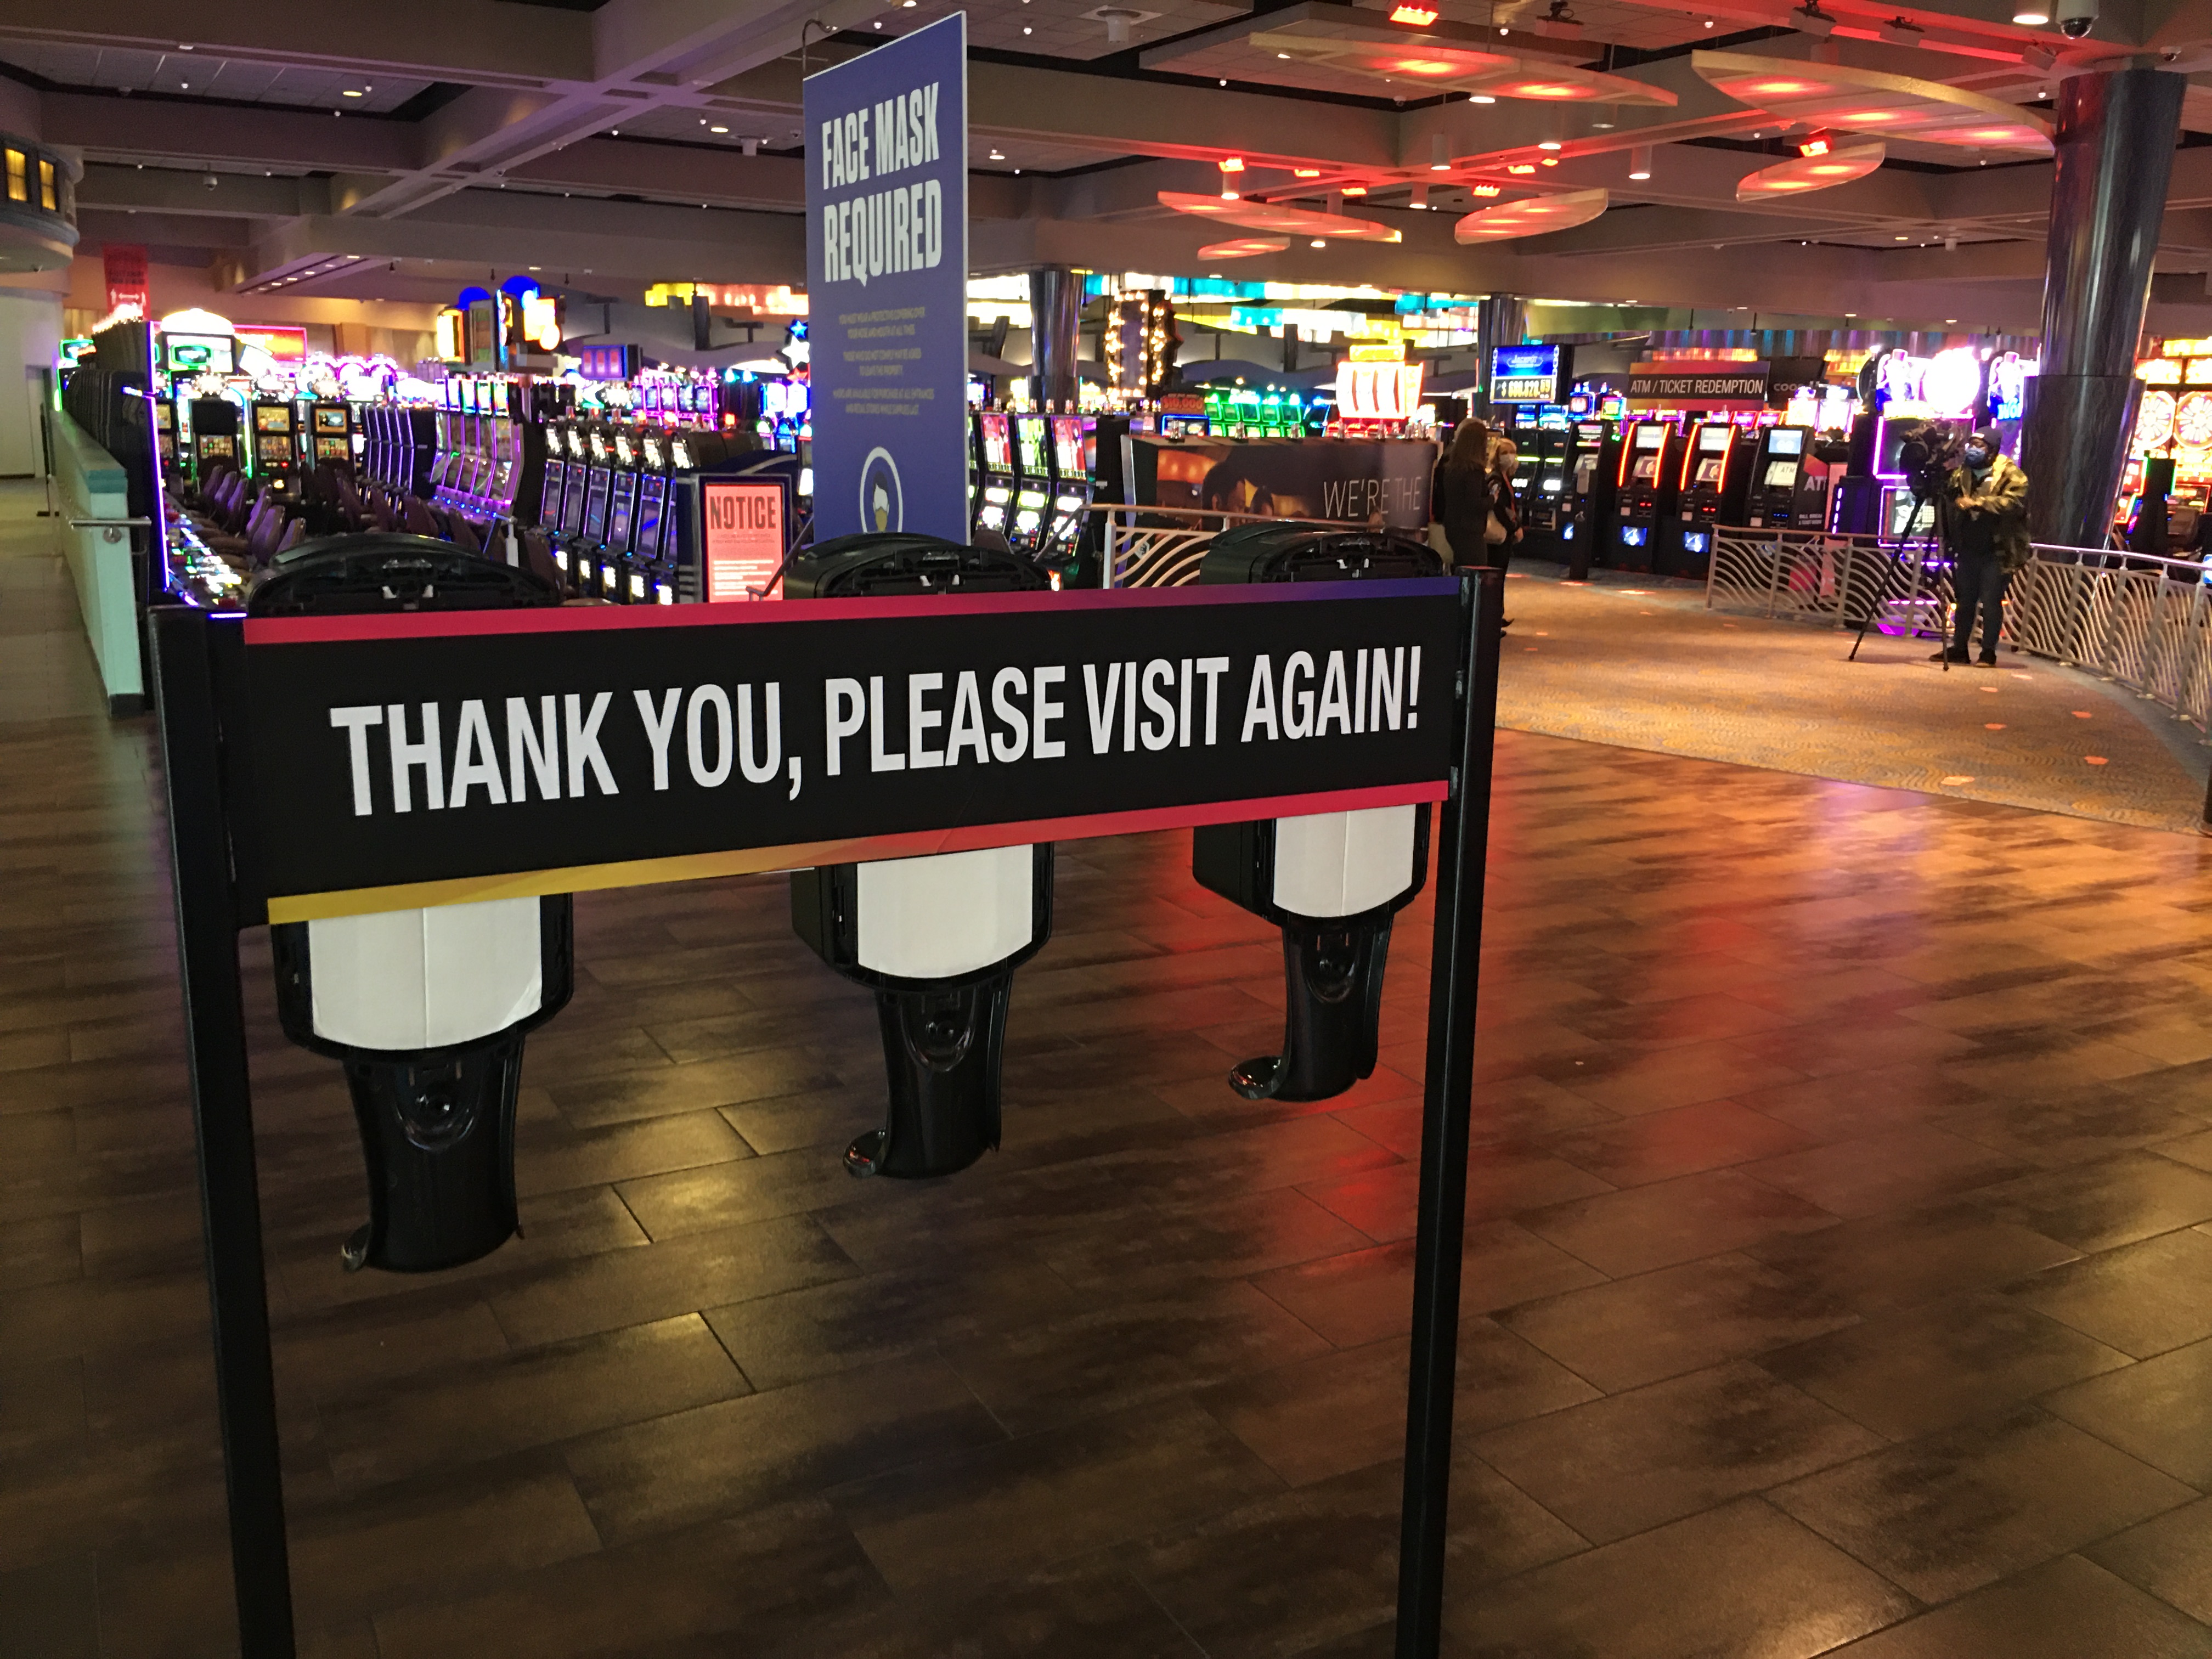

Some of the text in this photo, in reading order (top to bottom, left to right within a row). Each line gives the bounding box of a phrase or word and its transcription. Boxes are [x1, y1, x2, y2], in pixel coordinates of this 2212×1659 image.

[822, 82, 940, 190] FACE MASK
[824, 179, 942, 287] REQUIRED
[1630, 380, 1651, 393] ATM
[1659, 380, 1693, 393] TICKET
[1695, 380, 1764, 394] REDEMPTION
[709, 495, 777, 529] NOTICE
[1323, 476, 1422, 518] WE'RE THE
[329, 645, 1422, 816] THANK YOU, PLEASE VISIT AGAIN!
